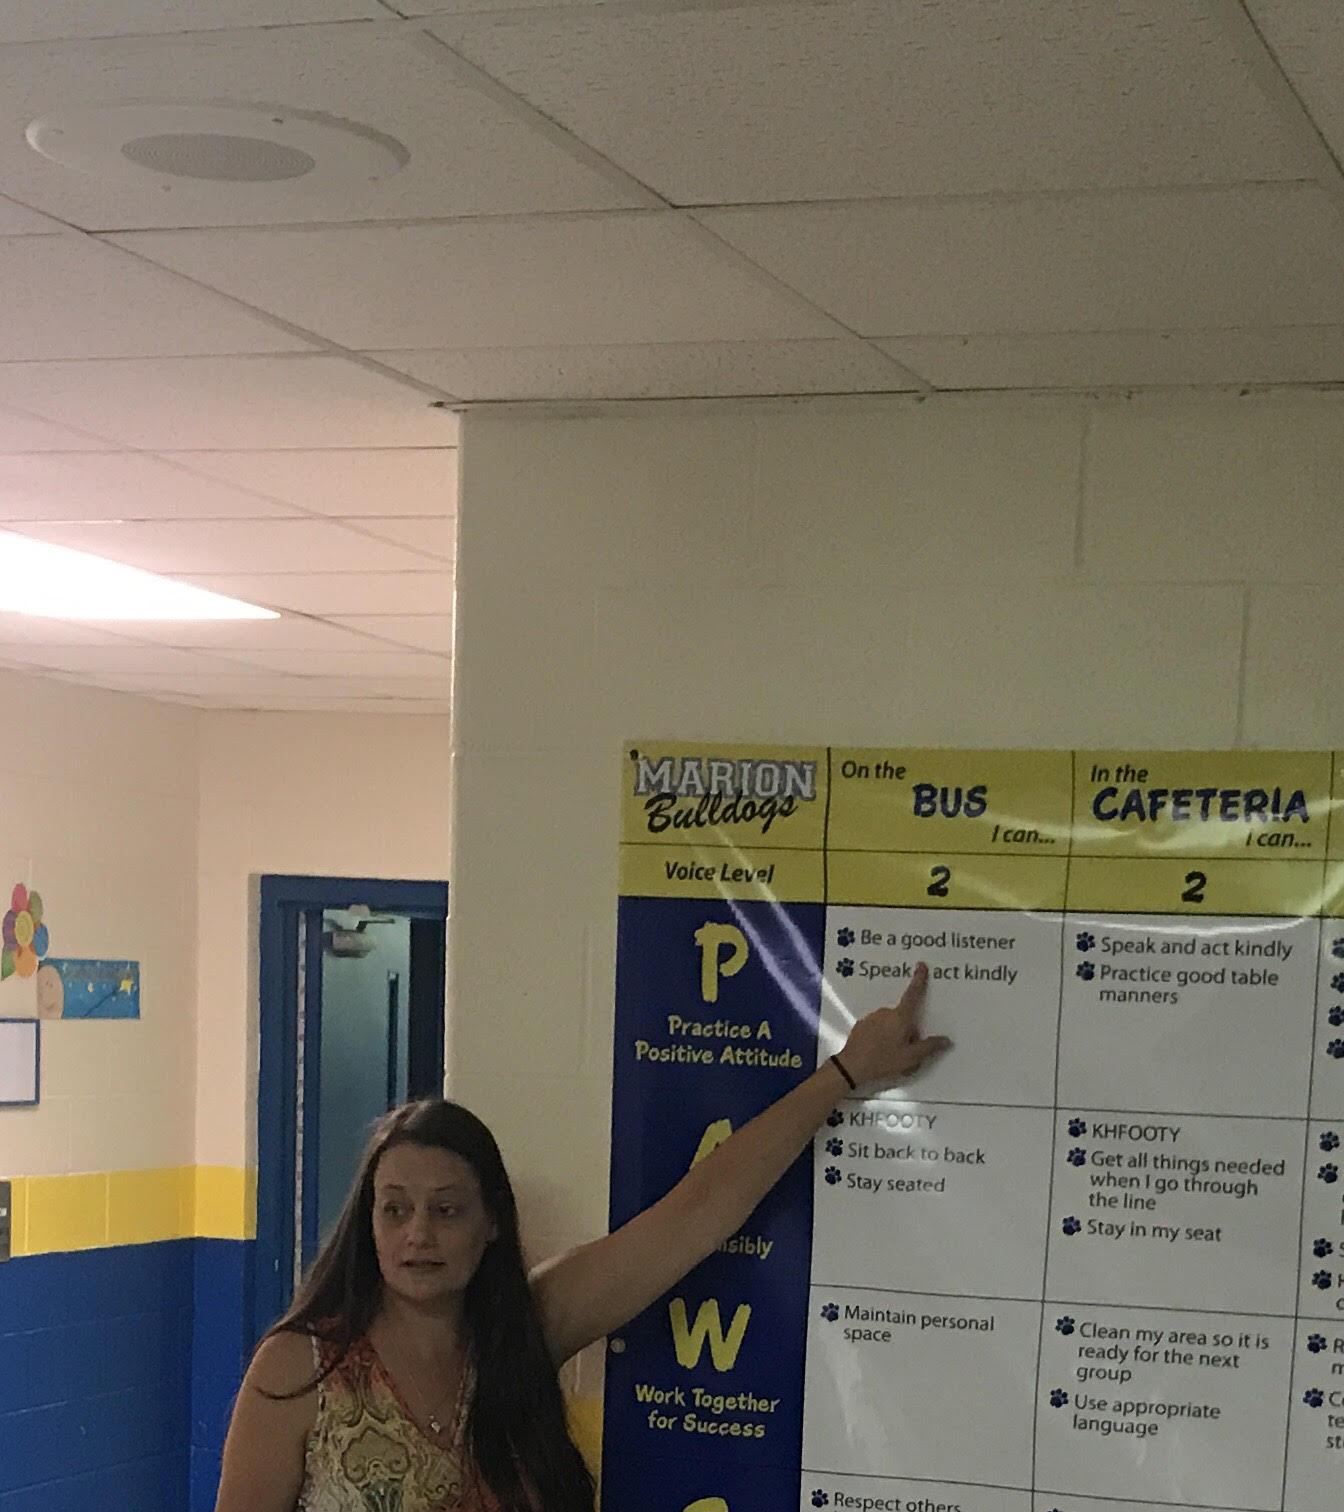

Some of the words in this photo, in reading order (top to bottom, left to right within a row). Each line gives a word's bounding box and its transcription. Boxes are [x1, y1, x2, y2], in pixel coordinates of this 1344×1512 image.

[634, 756, 816, 800] MARION
[841, 760, 870, 779] On
[874, 760, 907, 780] the
[1090, 764, 1110, 783] In
[1115, 763, 1149, 784] the
[645, 791, 798, 834] Bulldogs
[913, 784, 988, 819] BUS
[1092, 786, 1309, 826] CAFETERIA
[991, 824, 1000, 843] I
[1245, 831, 1253, 847] I
[665, 860, 716, 881] Voice
[719, 862, 775, 885] Level
[927, 866, 951, 898] 2
[1181, 872, 1207, 903] 2
[860, 928, 883, 946] Be
[886, 933, 897, 946] a
[900, 931, 947, 951] good
[951, 931, 1016, 950] listener
[695, 921, 749, 1003] P
[1100, 964, 1172, 983] Practice
[1176, 967, 1226, 987] good
[1231, 967, 1279, 986] table
[1099, 989, 1178, 1005] manners
[667, 1014, 752, 1039] Practice
[756, 1020, 772, 1040] A
[634, 1039, 714, 1064] Positive
[719, 1045, 803, 1068] Attitude
[846, 1172, 883, 1194] Stay
[887, 1177, 946, 1192] seated
[844, 1304, 916, 1325] Maintain
[920, 1315, 994, 1331] personal
[669, 1297, 751, 1372] W
[843, 1327, 892, 1343] space
[635, 1384, 686, 1407] Work
[691, 1387, 781, 1414] Together
[1074, 1393, 1108, 1411] Use
[1112, 1400, 1221, 1420] appropriate
[647, 1409, 678, 1430] for
[682, 1413, 765, 1438] Success
[1072, 1413, 1159, 1439] language
[833, 1491, 902, 1512] Respect
